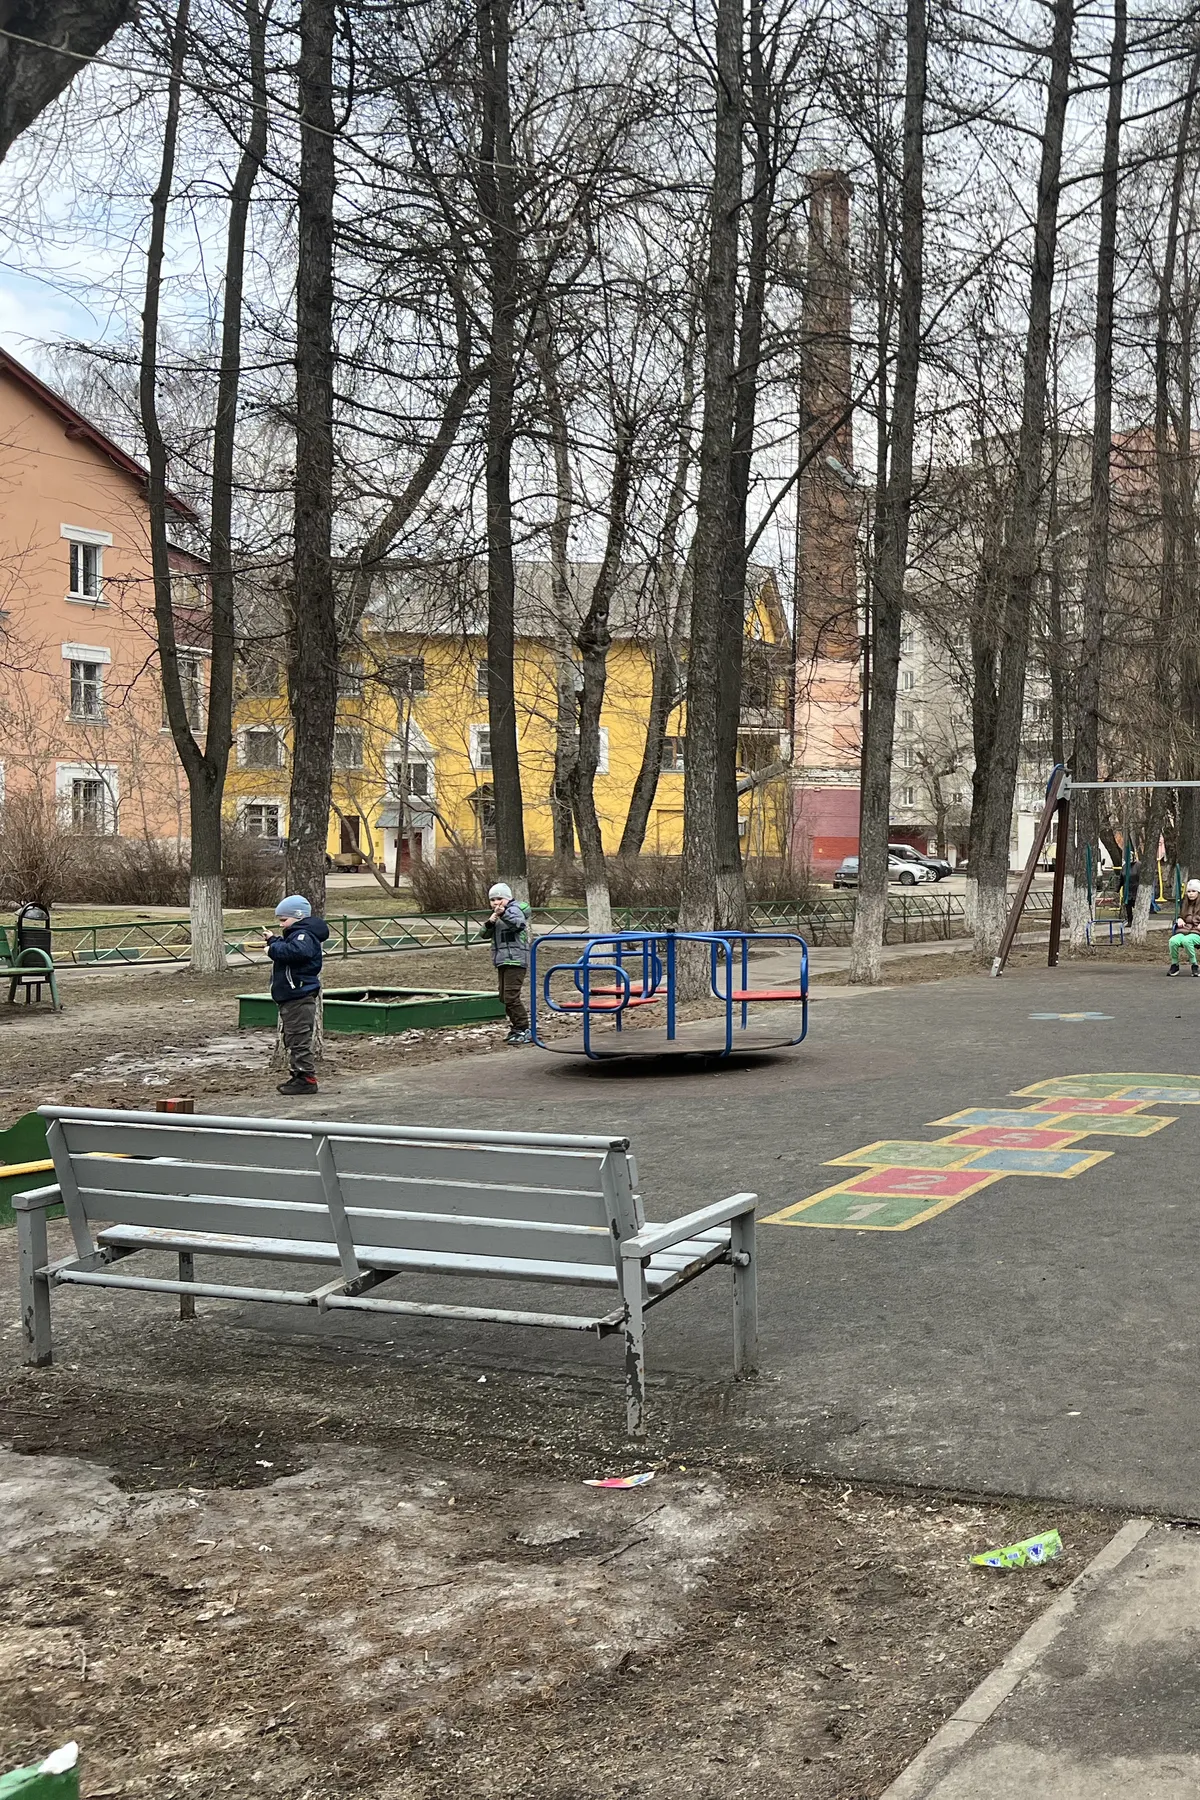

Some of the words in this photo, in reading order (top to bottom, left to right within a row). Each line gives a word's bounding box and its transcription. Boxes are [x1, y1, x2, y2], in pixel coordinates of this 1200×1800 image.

[1069, 1101, 1109, 1111] 8
[1087, 1117, 1129, 1129] 7
[990, 1132, 1041, 1144] 5
[881, 1145, 932, 1161] 3
[887, 1174, 948, 1190] 2
[844, 1202, 889, 1221] 1
